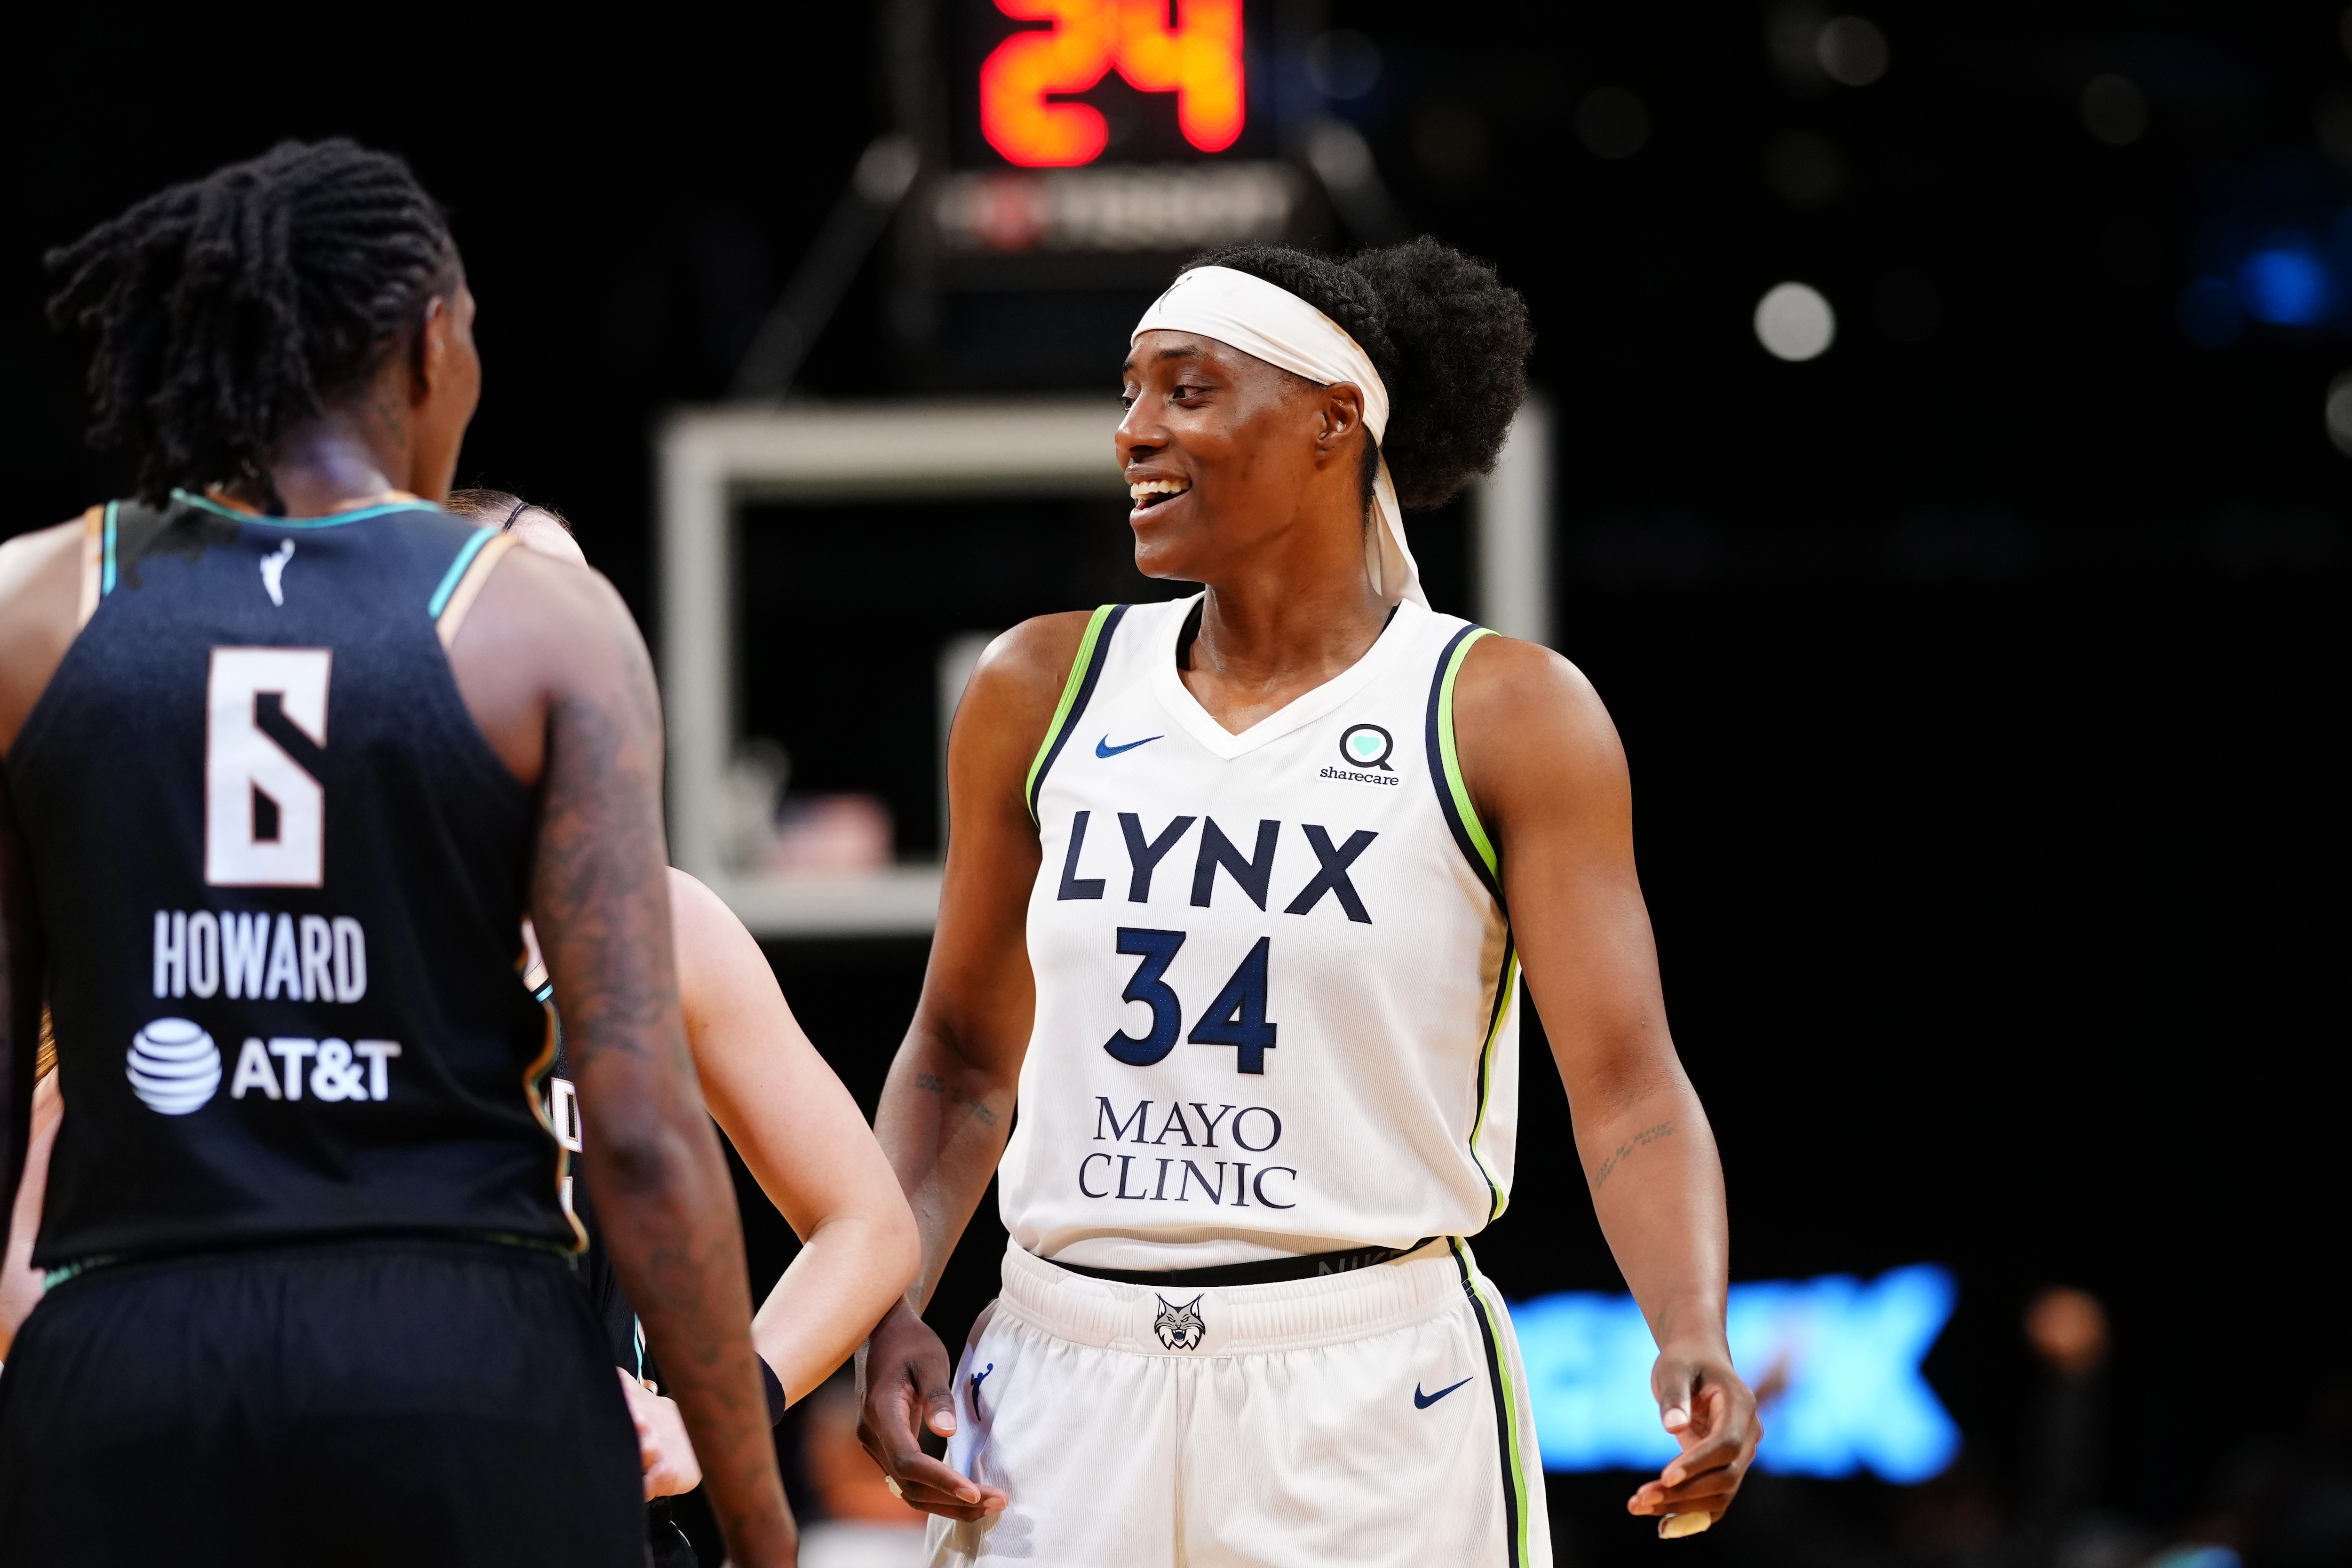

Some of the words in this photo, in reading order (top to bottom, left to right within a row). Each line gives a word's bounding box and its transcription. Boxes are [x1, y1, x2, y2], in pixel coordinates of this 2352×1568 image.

[980, 0, 1245, 167] 24
[205, 645, 333, 887] 6
[1320, 766, 1399, 785] sharecare
[1057, 810, 1379, 924] LYNX
[153, 911, 366, 1003] HOWARD
[1103, 927, 1277, 1075] 34
[231, 1037, 401, 1102] AT&T
[1093, 1096, 1281, 1152] MAYO
[1079, 1153, 1297, 1209] CLINIC
